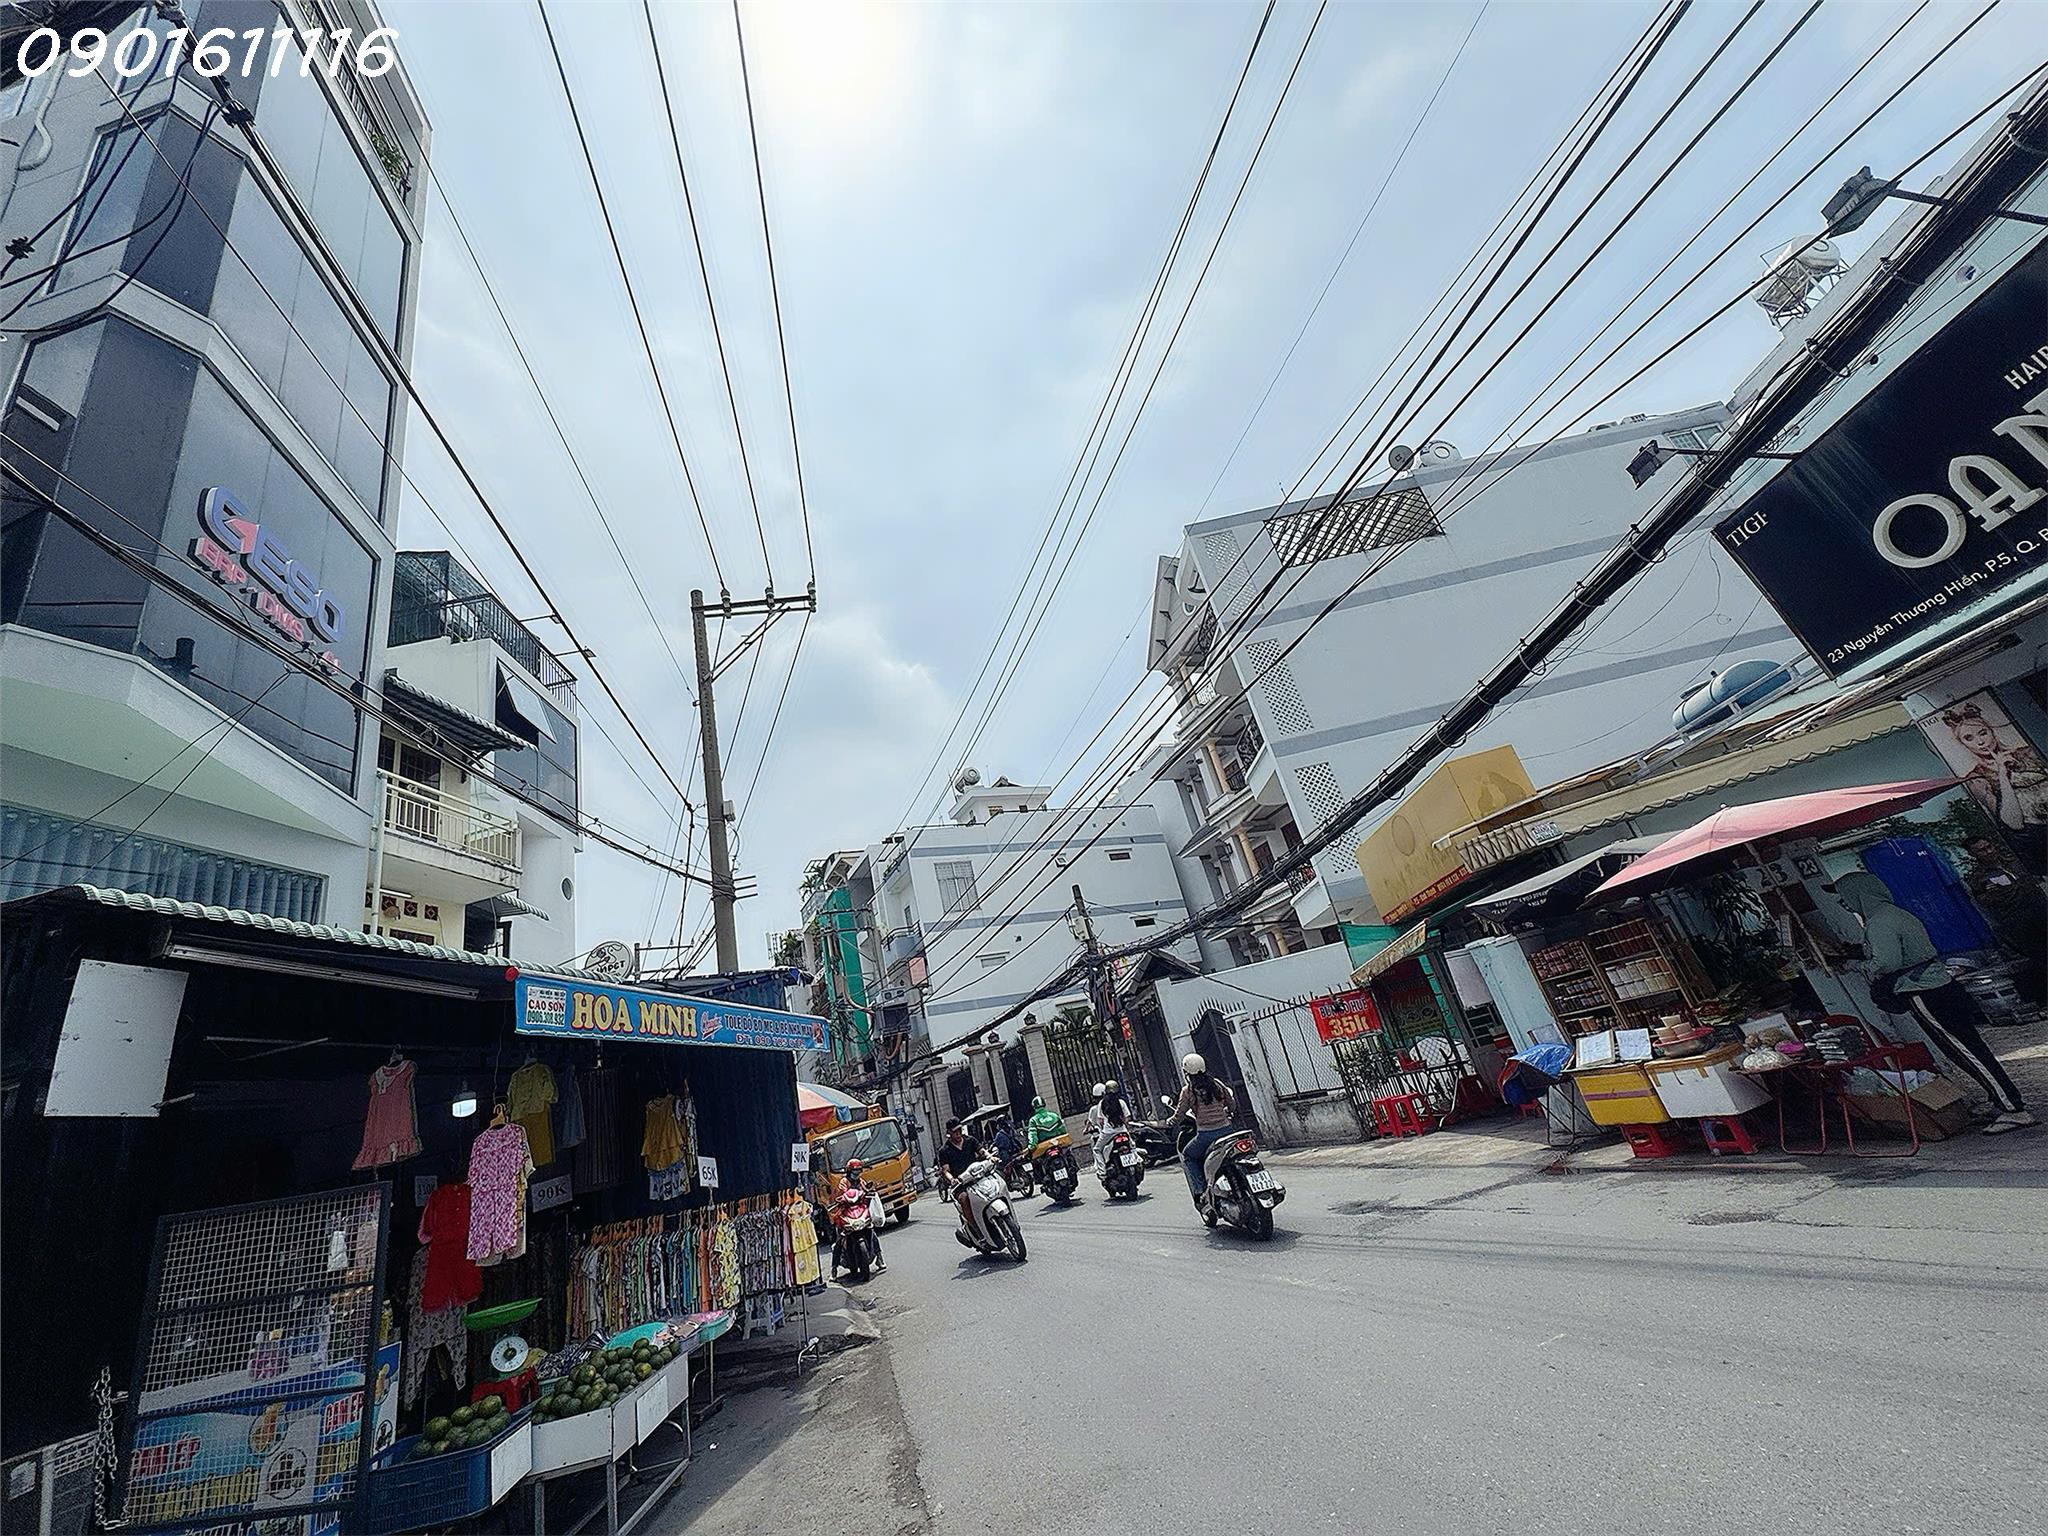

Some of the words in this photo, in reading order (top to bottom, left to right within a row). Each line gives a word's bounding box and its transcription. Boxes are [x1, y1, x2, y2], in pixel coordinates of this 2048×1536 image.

[1727, 510, 1769, 548] TIGI
[188, 537, 247, 585] ERP
[252, 591, 305, 641] DMS
[1827, 648, 1845, 664] 23
[1844, 622, 1894, 655] Nguyễn
[1890, 593, 1947, 627] Thượng
[1985, 551, 2018, 573] P.5,
[2016, 540, 2041, 554] Q.
[1799, 859, 1818, 875] 23
[528, 998, 546, 1010] CAO
[571, 992, 633, 1032] HOA
[639, 1001, 698, 1037] MINH
[702, 1166, 717, 1181] 65K
[537, 1183, 568, 1202] 90K
